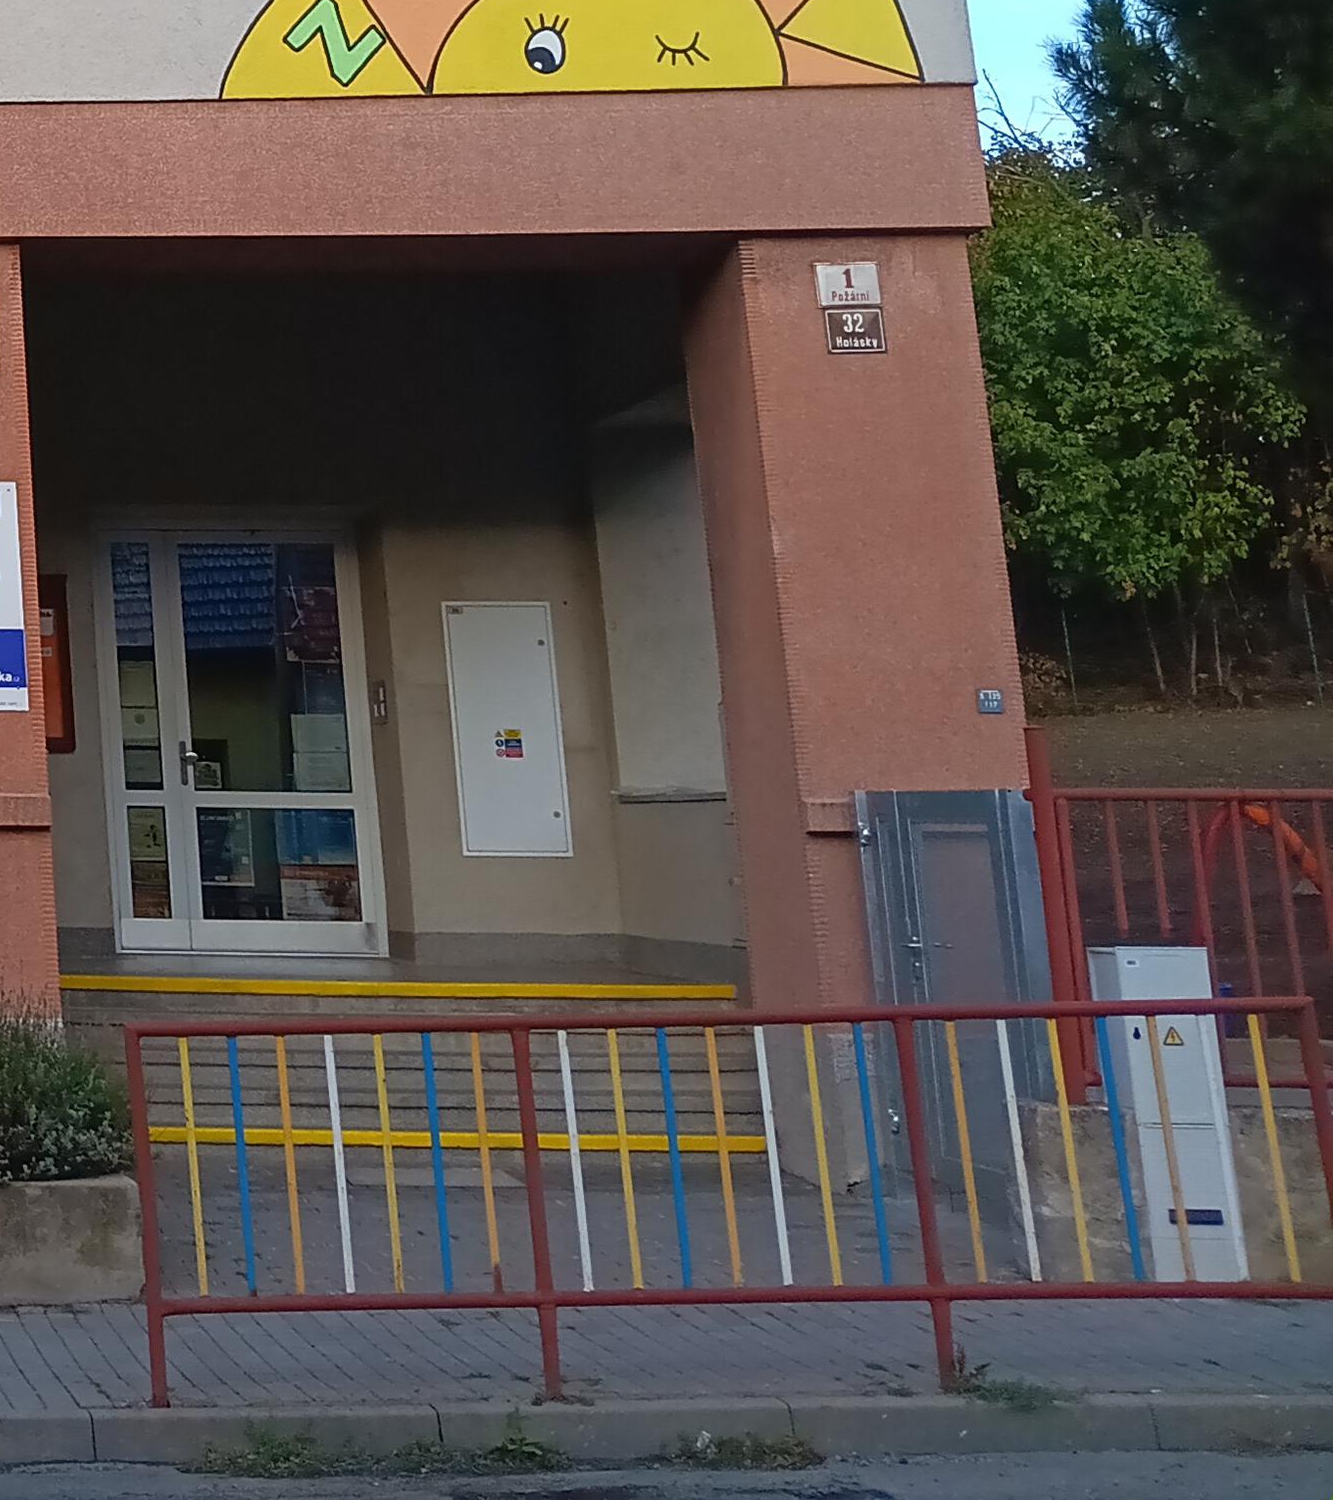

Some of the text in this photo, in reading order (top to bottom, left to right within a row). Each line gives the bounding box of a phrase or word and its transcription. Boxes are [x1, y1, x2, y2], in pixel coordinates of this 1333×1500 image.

[842, 268, 854, 289] 1
[831, 290, 870, 302] Požární
[842, 313, 865, 333] 32
[836, 336, 878, 348] Holásky
